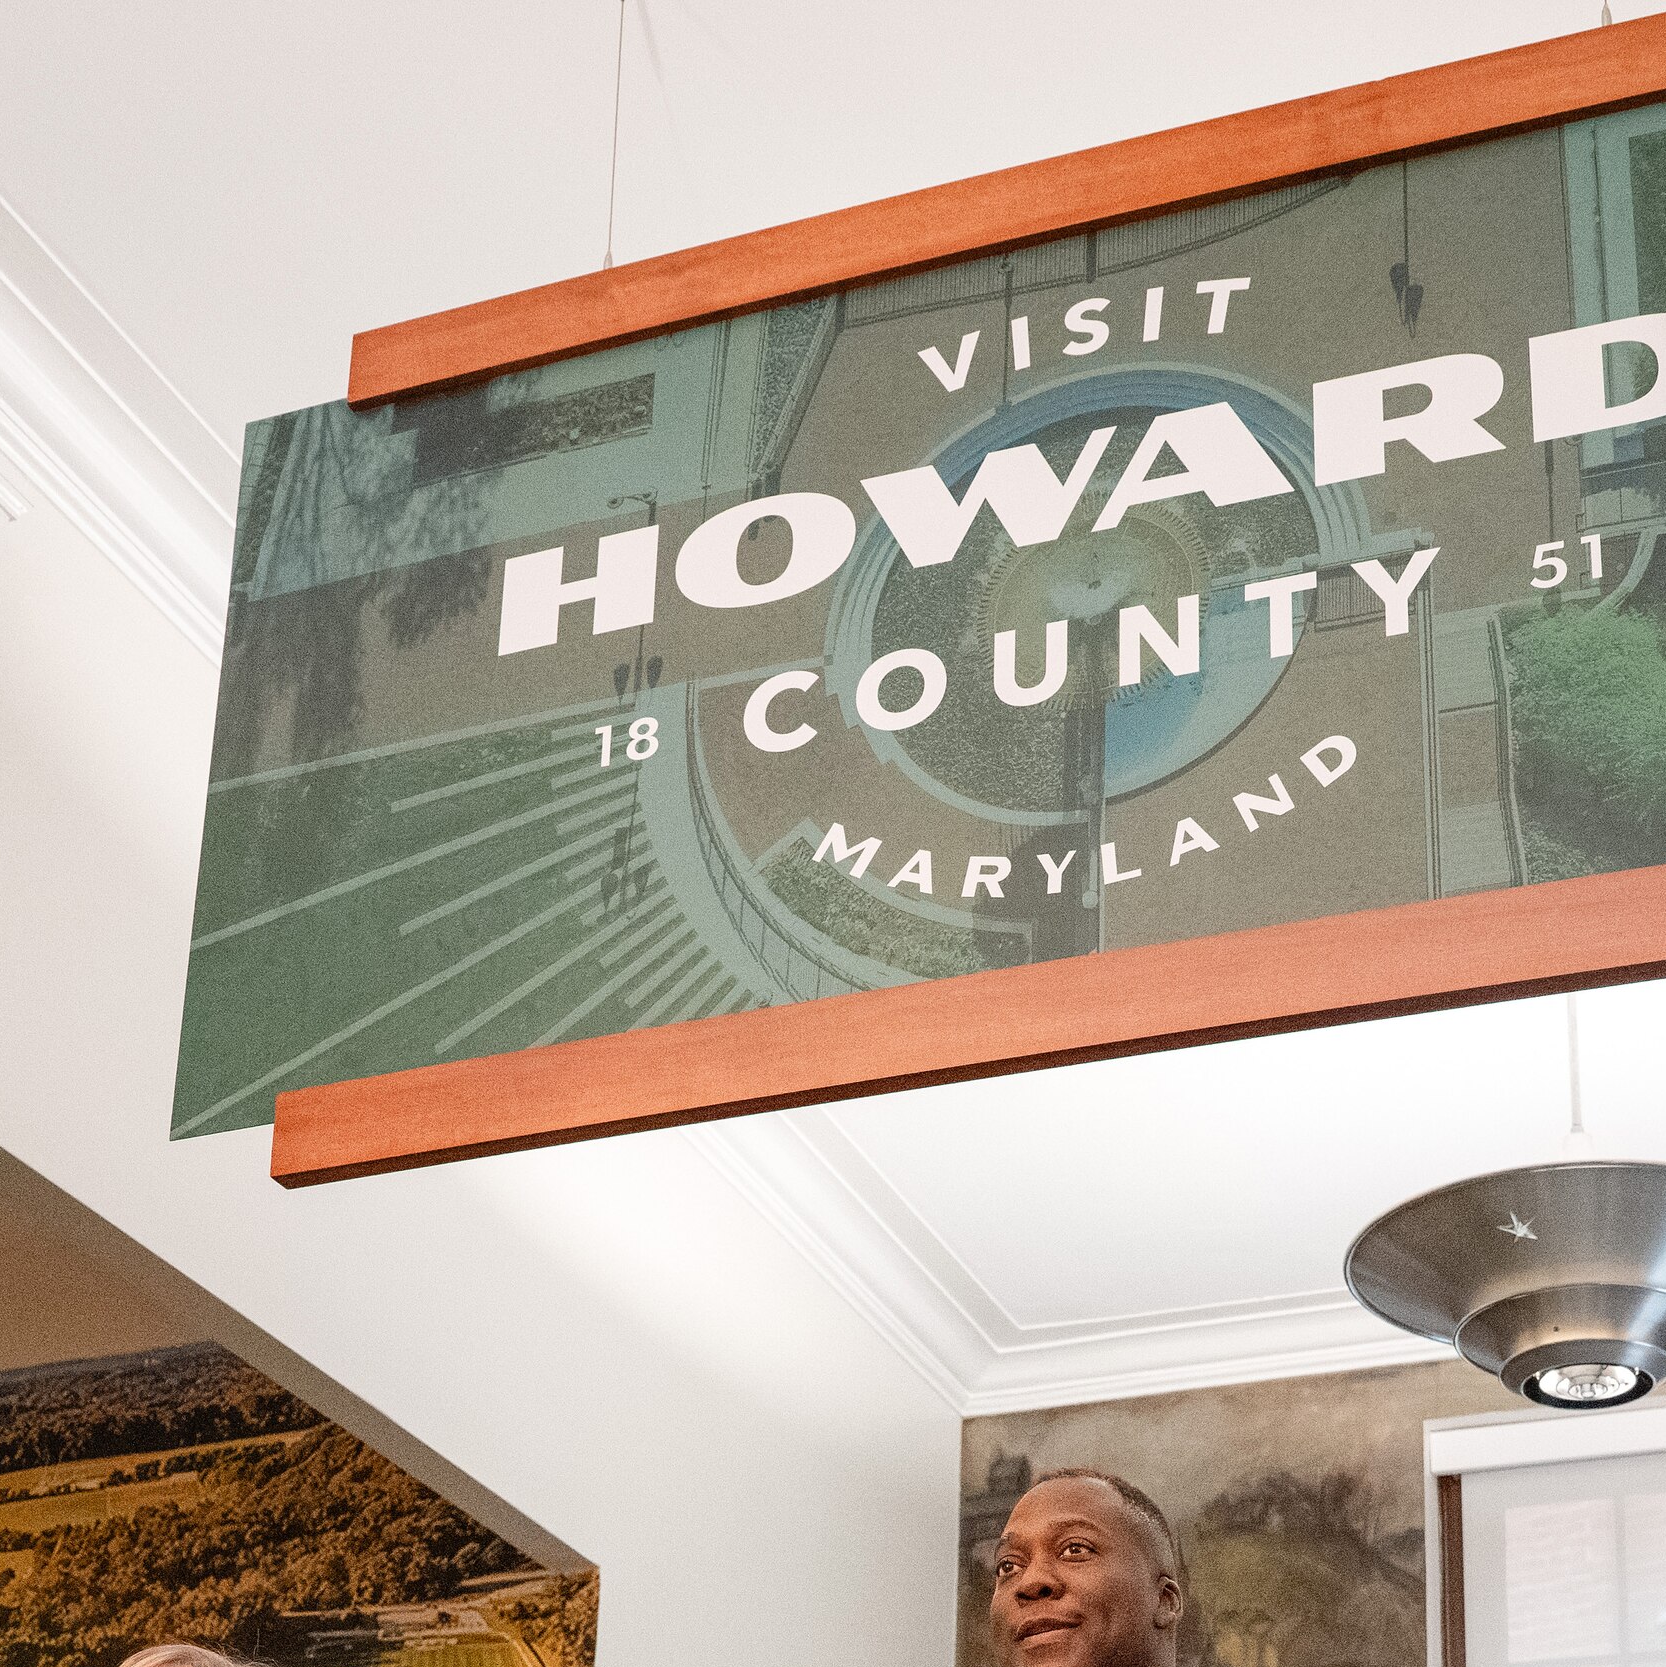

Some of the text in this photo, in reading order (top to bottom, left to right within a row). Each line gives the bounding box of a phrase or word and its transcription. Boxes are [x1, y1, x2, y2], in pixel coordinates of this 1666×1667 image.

[917, 276, 1251, 393] VISIT
[594, 533, 1603, 768] 18 COUNTY 51
[811, 734, 1358, 898] MARYLAND
